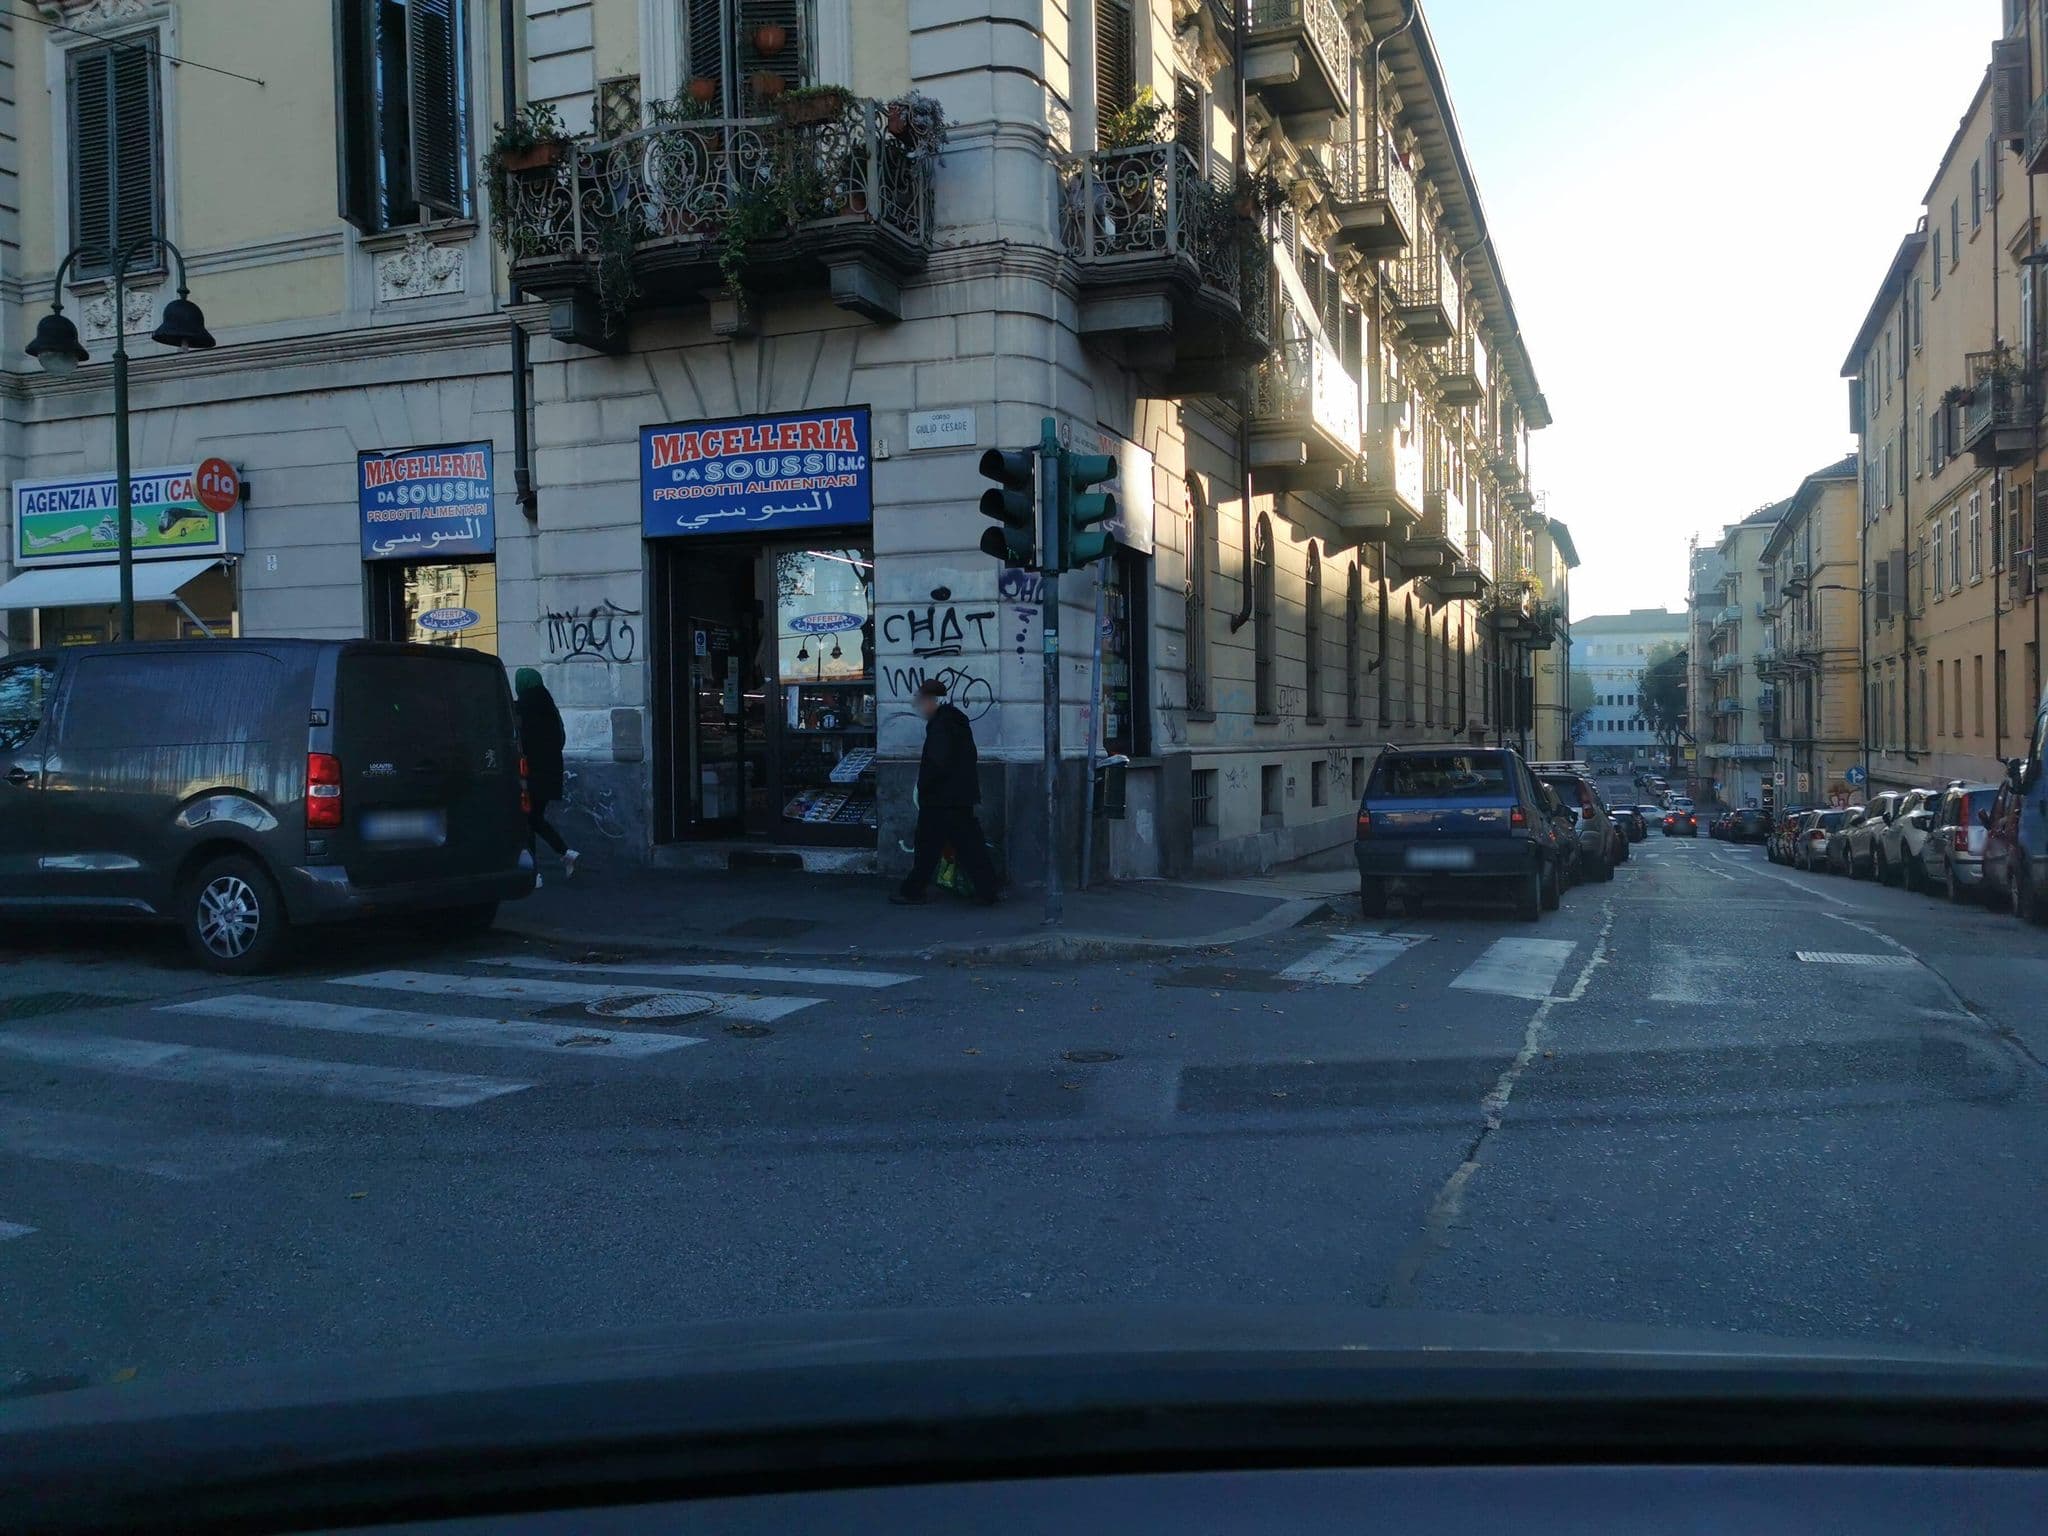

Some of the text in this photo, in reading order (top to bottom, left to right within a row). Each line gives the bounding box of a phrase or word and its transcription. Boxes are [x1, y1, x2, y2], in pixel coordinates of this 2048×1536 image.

[652, 417, 857, 468] MACELLERIA
[202, 464, 234, 496] ria
[365, 452, 487, 489] MACELLERIA
[671, 468, 700, 482] DA
[705, 453, 837, 482] SOUSSI
[26, 488, 97, 513] AGENZIA
[101, 483, 159, 508] VIGGI
[378, 491, 394, 503] DA
[397, 481, 475, 505] SOUSSI
[653, 474, 857, 501] PRODOTTI ALIMENTARI
[367, 504, 487, 522] PRODOTTI ALIMENTARI
[883, 606, 995, 650] CHAT
